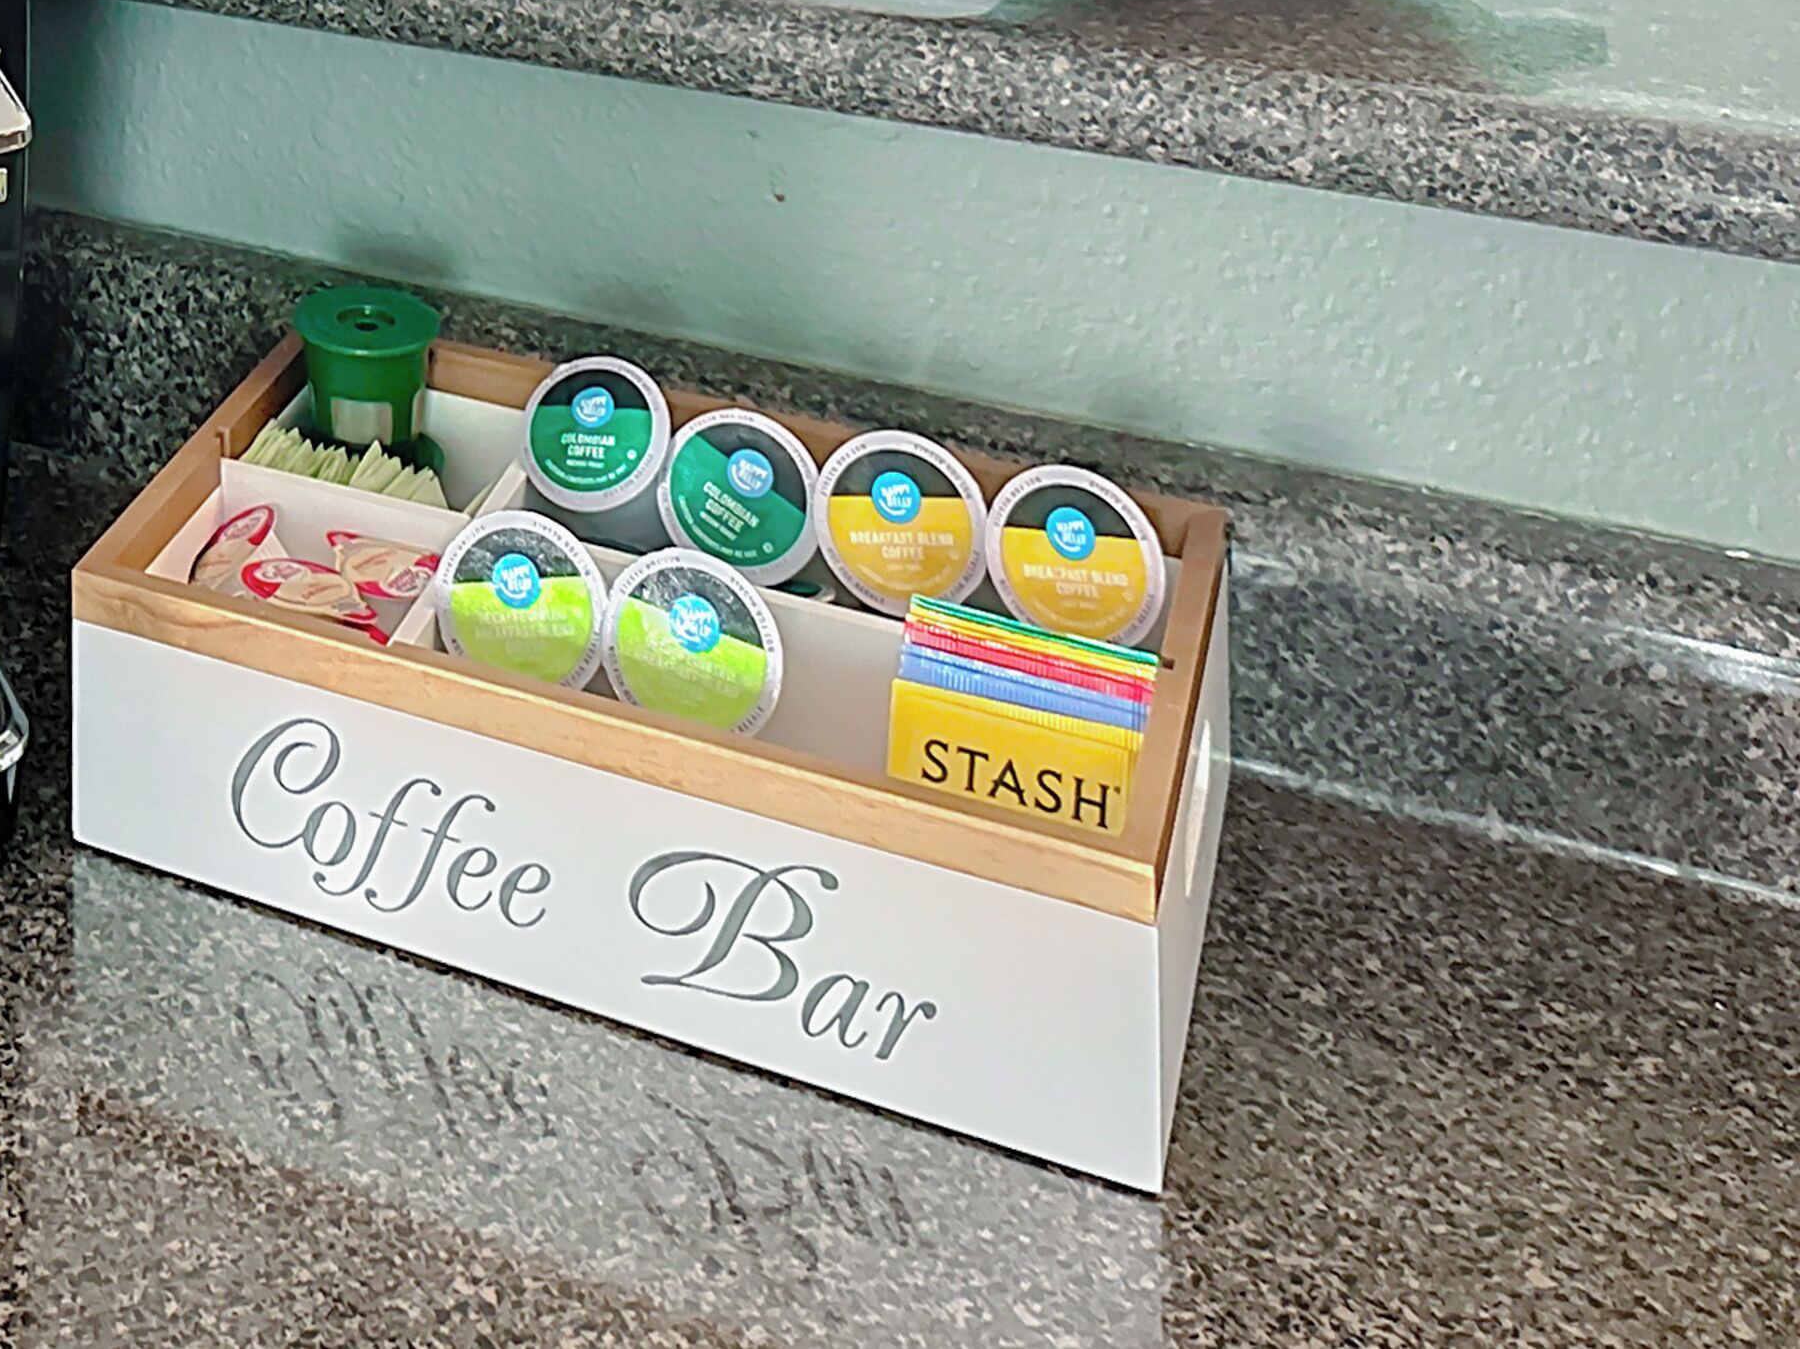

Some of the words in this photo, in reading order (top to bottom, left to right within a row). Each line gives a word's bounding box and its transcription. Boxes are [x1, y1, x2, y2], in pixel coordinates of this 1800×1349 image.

[560, 432, 616, 447] COLOMBIAN
[567, 445, 605, 459] COFFEE
[879, 483, 911, 498] HAPPY
[703, 481, 760, 529] COLOMBIAN
[705, 498, 745, 534] COFFEE
[850, 530, 914, 546] BREAKFAST
[916, 531, 954, 547] BLEND
[881, 545, 925, 561] COFFEE
[1091, 569, 1129, 587] BLEND
[1055, 581, 1100, 599] COFFEE
[920, 738, 1110, 830] STASH
[230, 717, 553, 928] Coffee
[627, 849, 938, 1062] Bar
